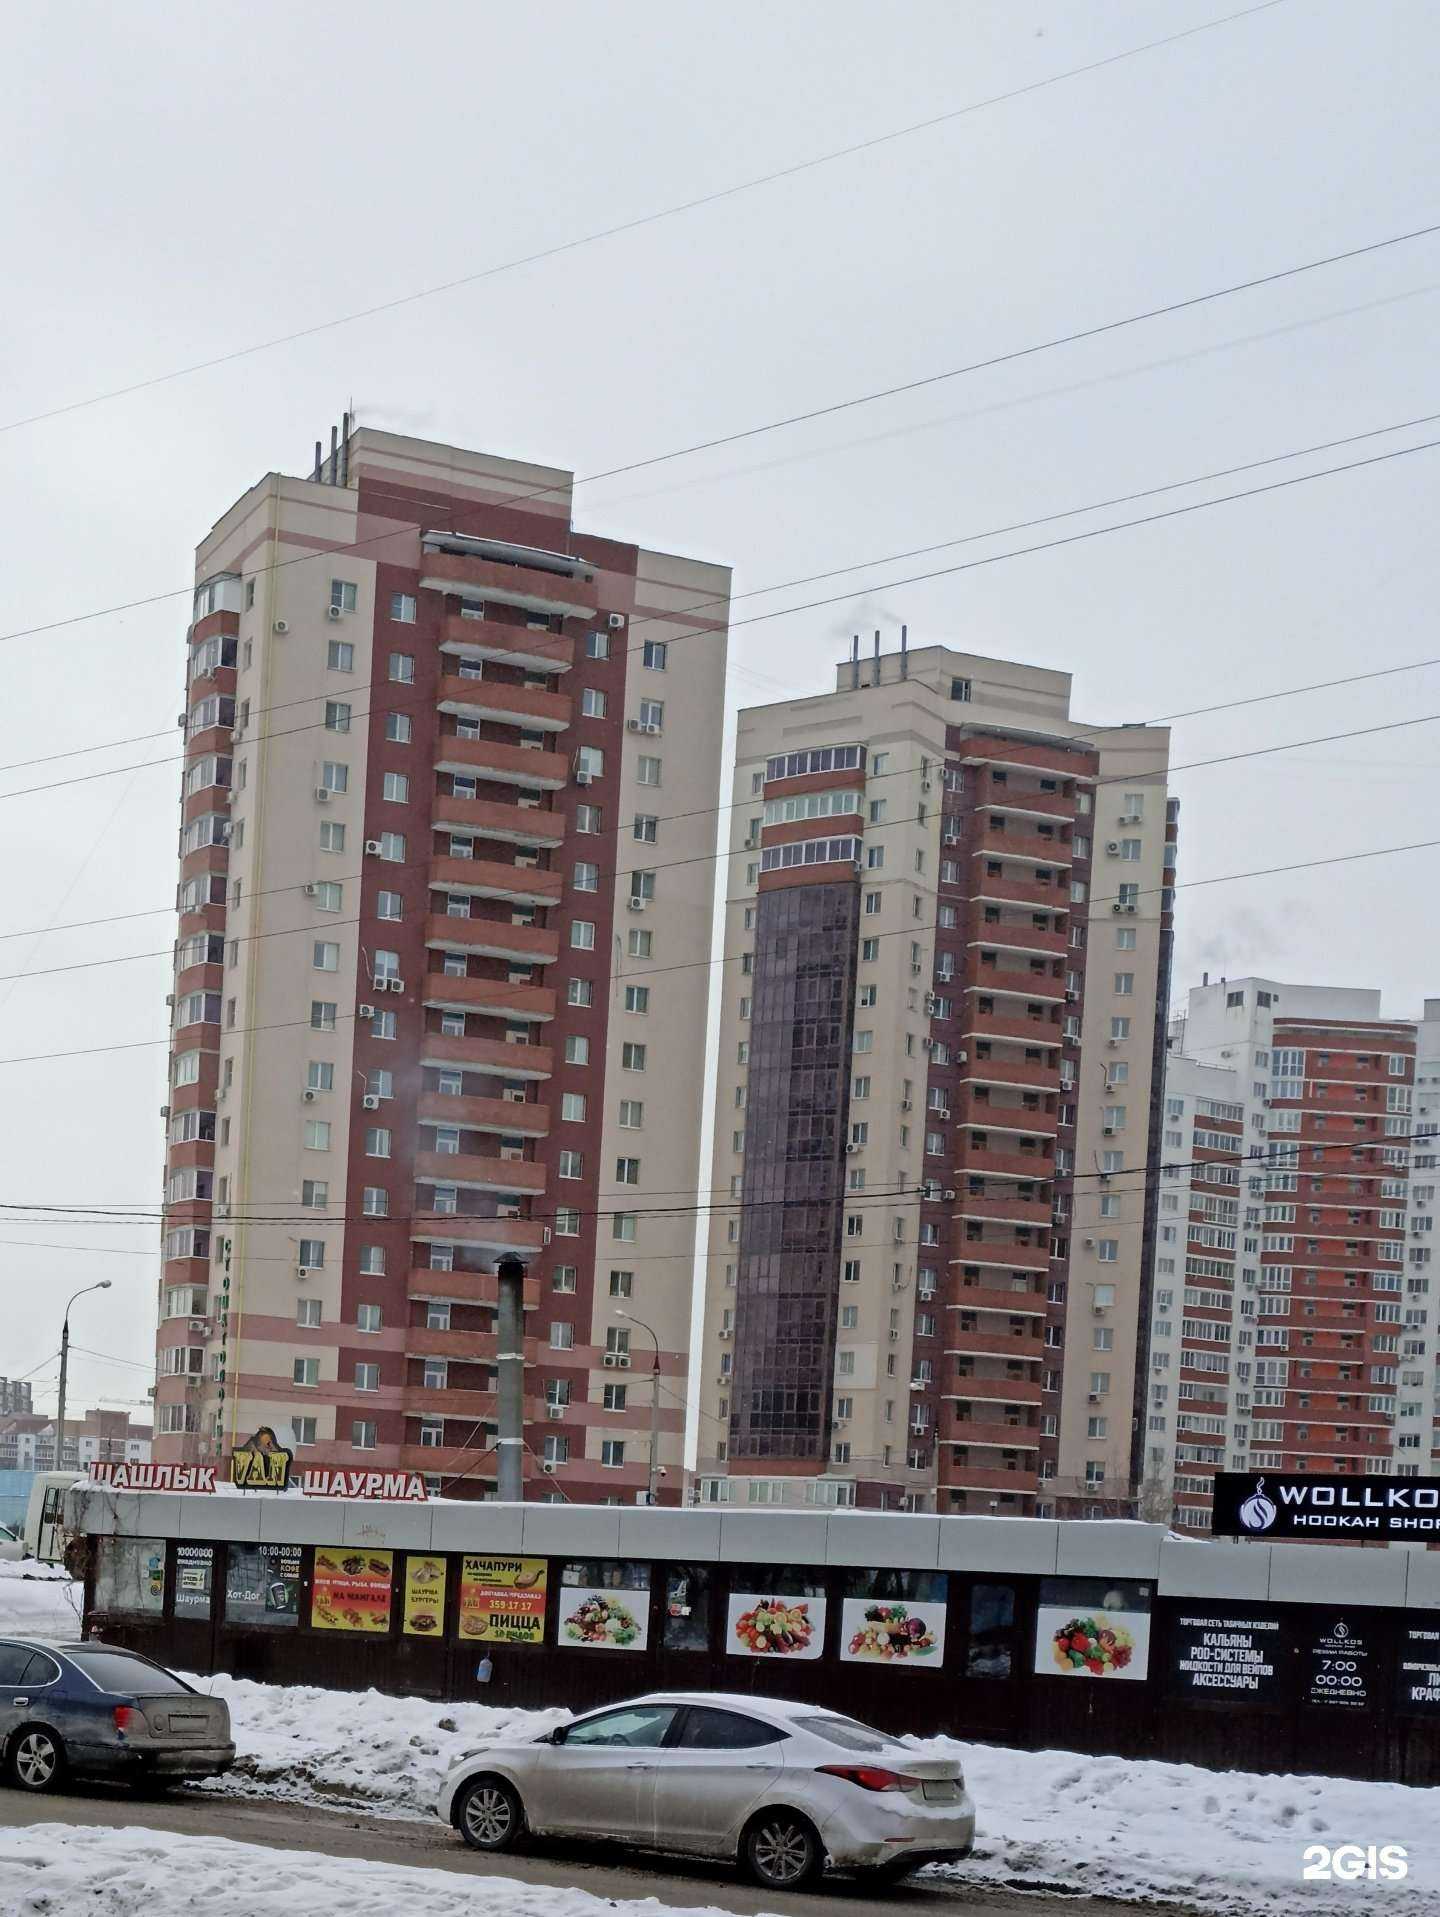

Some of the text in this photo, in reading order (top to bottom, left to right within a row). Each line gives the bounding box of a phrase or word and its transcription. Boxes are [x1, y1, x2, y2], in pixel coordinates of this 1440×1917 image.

[89, 1462, 216, 1490] ШАШЛЫК
[303, 1470, 427, 1499] ШАУРМА
[1293, 1514, 1379, 1528] HOOKAH
[259, 1546, 302, 1557] 10:00-00:00
[465, 1559, 523, 1572] ХАЧАПУРИ
[227, 1589, 260, 1601] Хот-Дог
[489, 1614, 541, 1631] ПИЦЦА
[1203, 1633, 1252, 1648] КАЛЬЯНЫ
[1319, 1638, 1363, 1646] WOLLKOS
[1179, 1660, 1274, 1676] ЖИДКОСТИ ДЛЯ ВЕЙПОВ
[1322, 1660, 1357, 1672] 7:00
[1192, 1672, 1259, 1690] АКСЕССУАРЫ
[1315, 1674, 1363, 1687] 00:00
